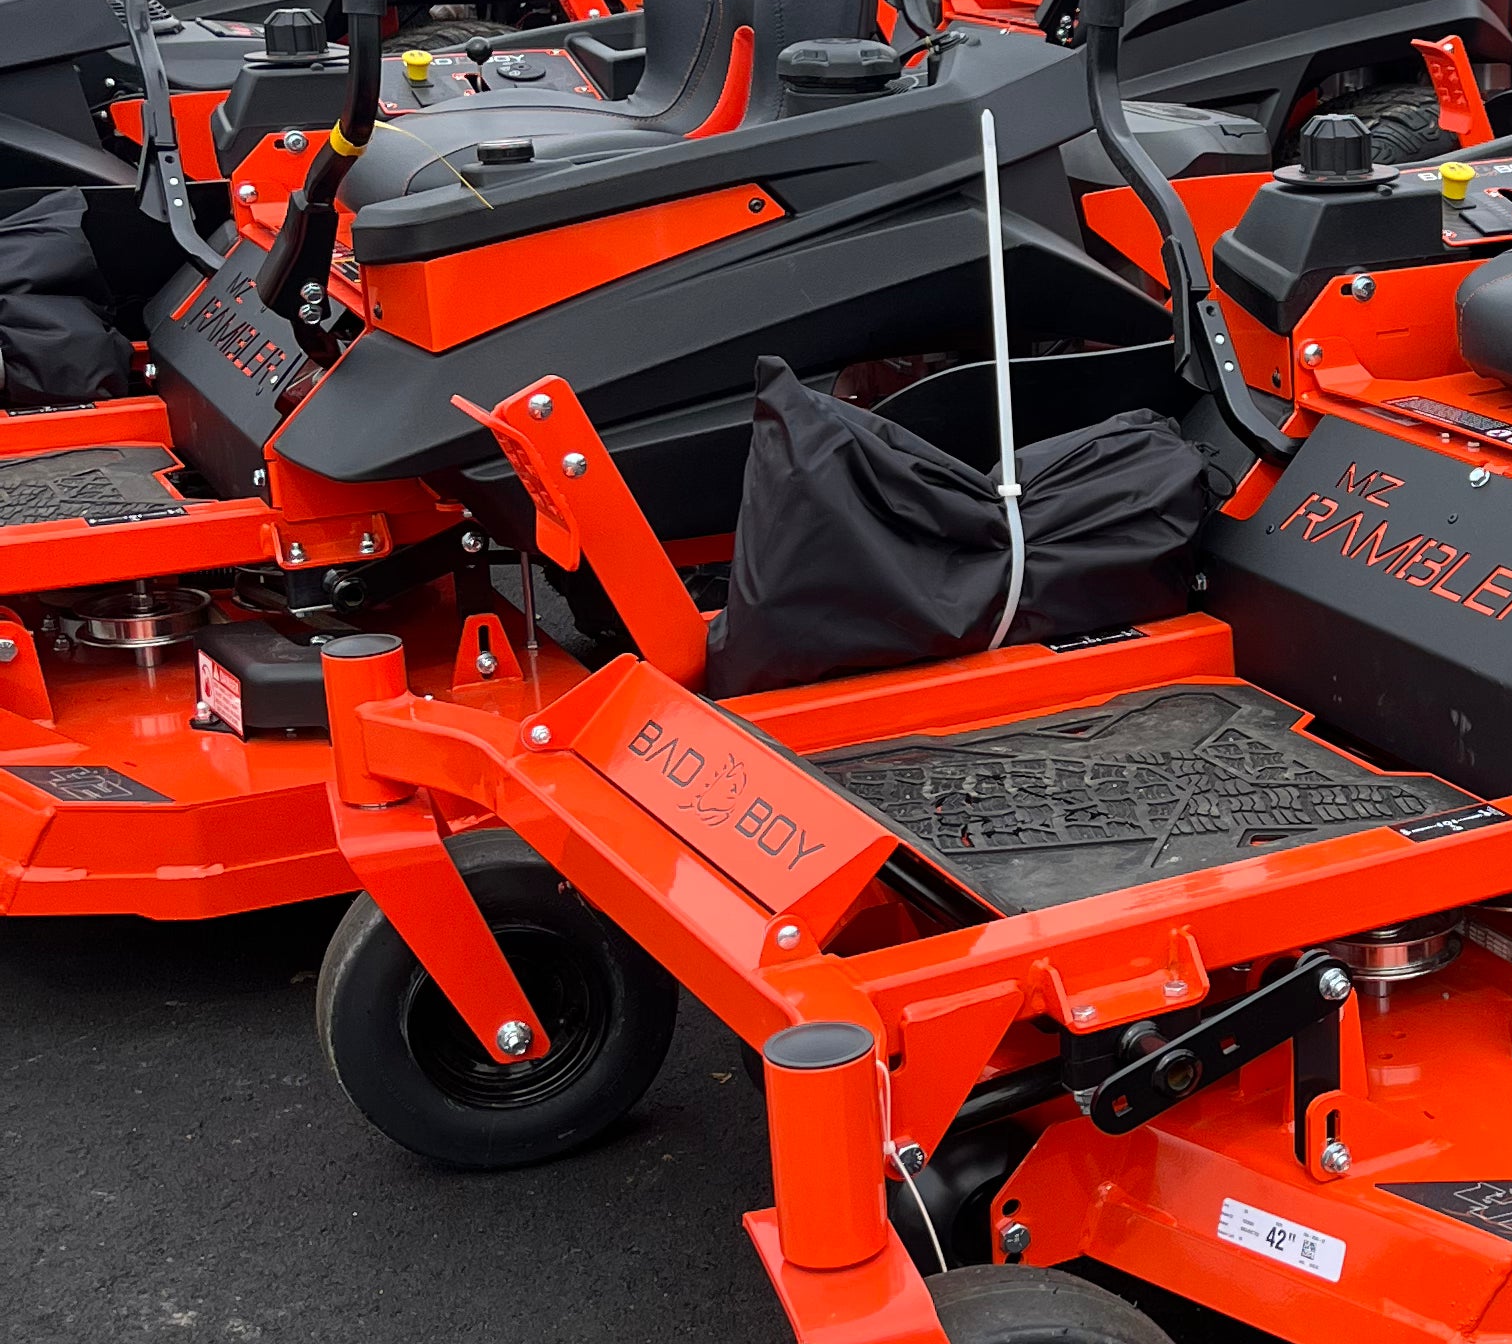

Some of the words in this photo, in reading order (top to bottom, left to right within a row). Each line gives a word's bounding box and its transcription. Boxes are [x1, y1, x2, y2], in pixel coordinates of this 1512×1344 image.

[226, 271, 257, 304] MZ
[189, 296, 287, 386] RAMBLER
[1336, 461, 1406, 508] MZ
[628, 719, 705, 788] BAD
[735, 797, 826, 870] BOY
